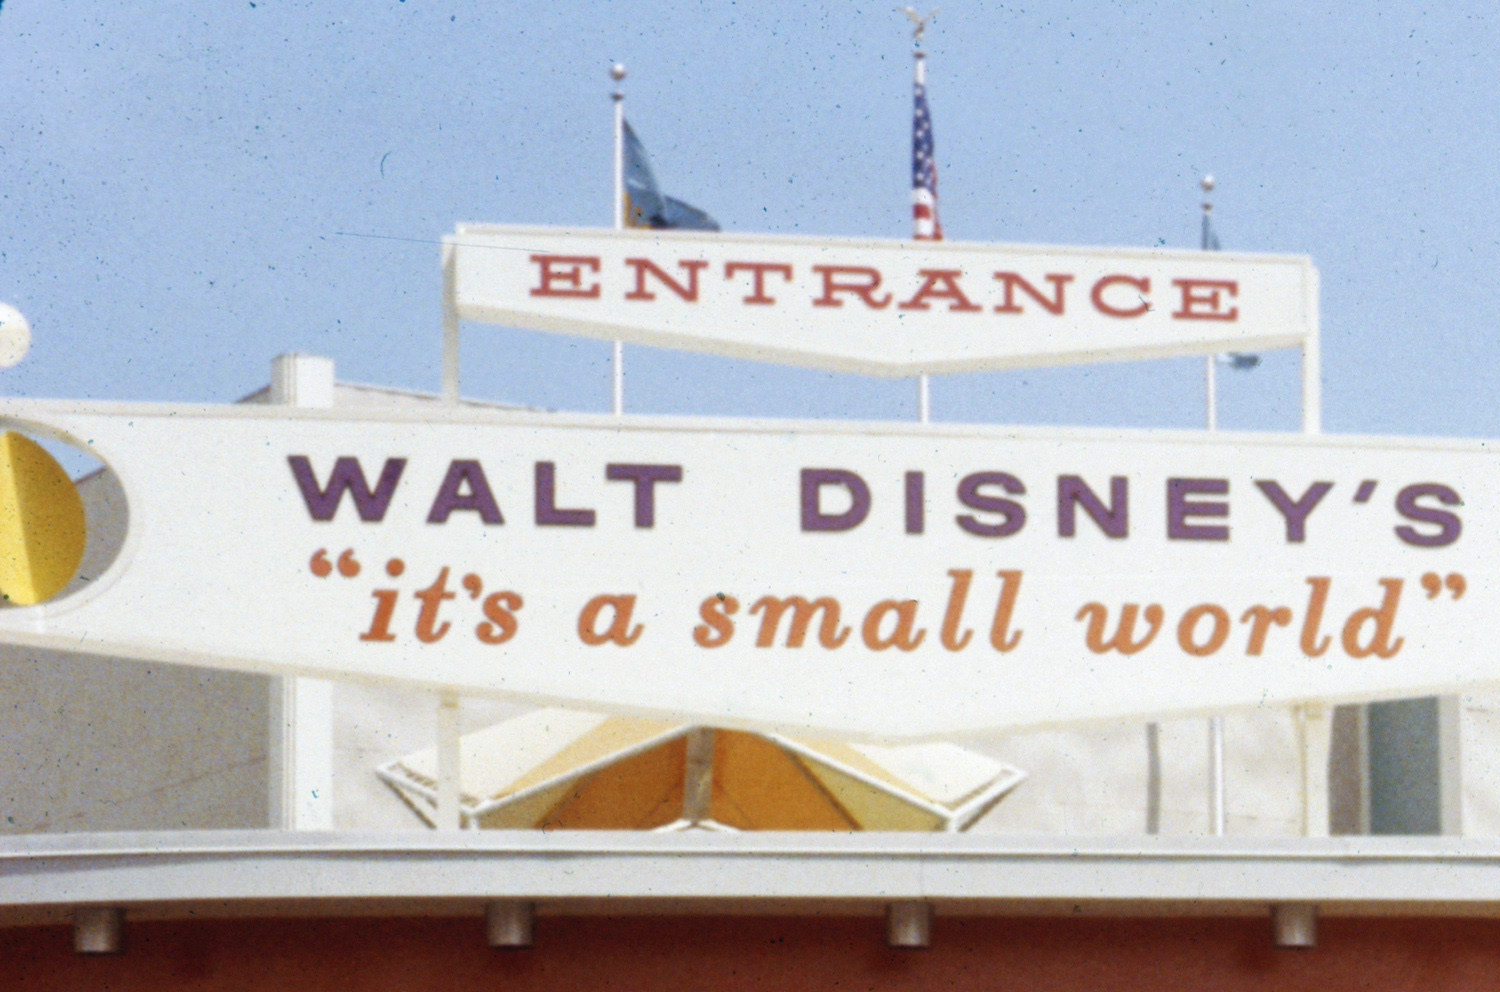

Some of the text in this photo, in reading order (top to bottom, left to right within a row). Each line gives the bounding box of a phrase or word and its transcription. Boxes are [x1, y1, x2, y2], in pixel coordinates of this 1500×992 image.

[529, 254, 1240, 322] ENTRANCE
[287, 454, 1464, 548] WALT DISNEY'S
[309, 547, 1468, 660] “it's a small world”
